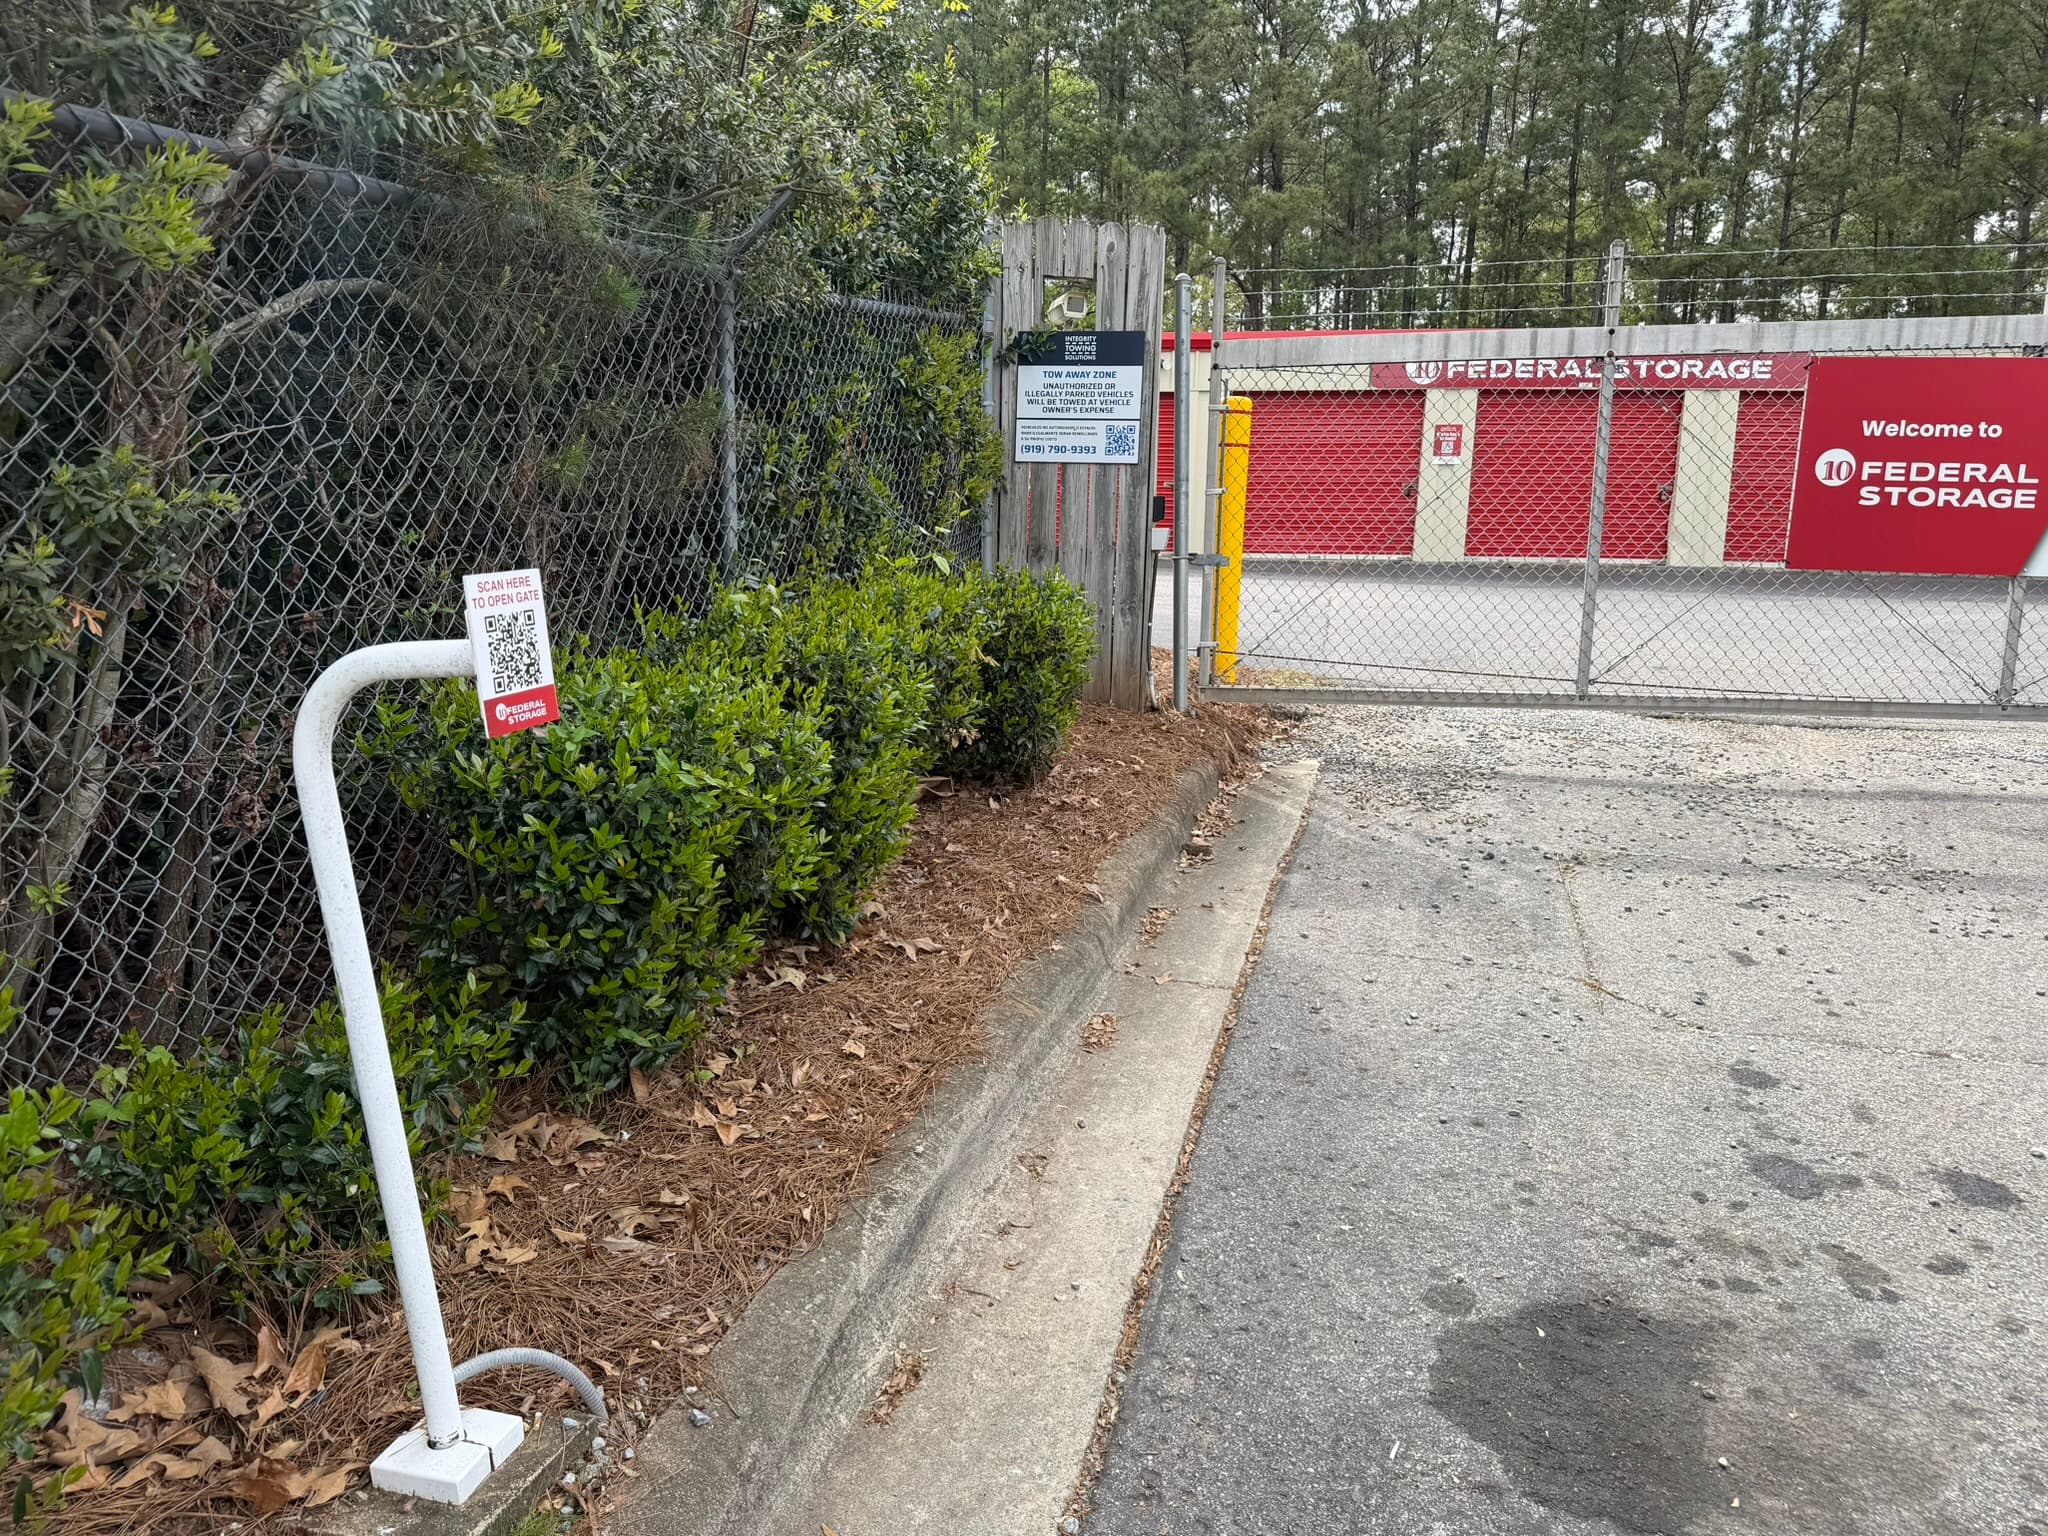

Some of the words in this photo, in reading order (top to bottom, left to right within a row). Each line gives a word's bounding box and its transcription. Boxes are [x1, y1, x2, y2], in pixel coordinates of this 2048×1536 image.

[1447, 360, 1602, 378] FEDERAL
[1614, 359, 1772, 379] STORAGE
[1862, 420, 1973, 438] Welcome
[1978, 422, 2003, 438] to
[1021, 445, 1044, 454] (919)
[1048, 446, 1096, 454] 790-9393
[1861, 462, 2039, 484] FEDERAL
[1859, 486, 2038, 509] STORAGE
[477, 579, 504, 593] SCAN
[506, 576, 531, 589] HERE
[472, 597, 485, 608] TO
[488, 593, 514, 607] OPEN
[516, 590, 539, 602] GATE
[507, 699, 545, 715] FEDERAL
[508, 707, 547, 724] STORAGE
